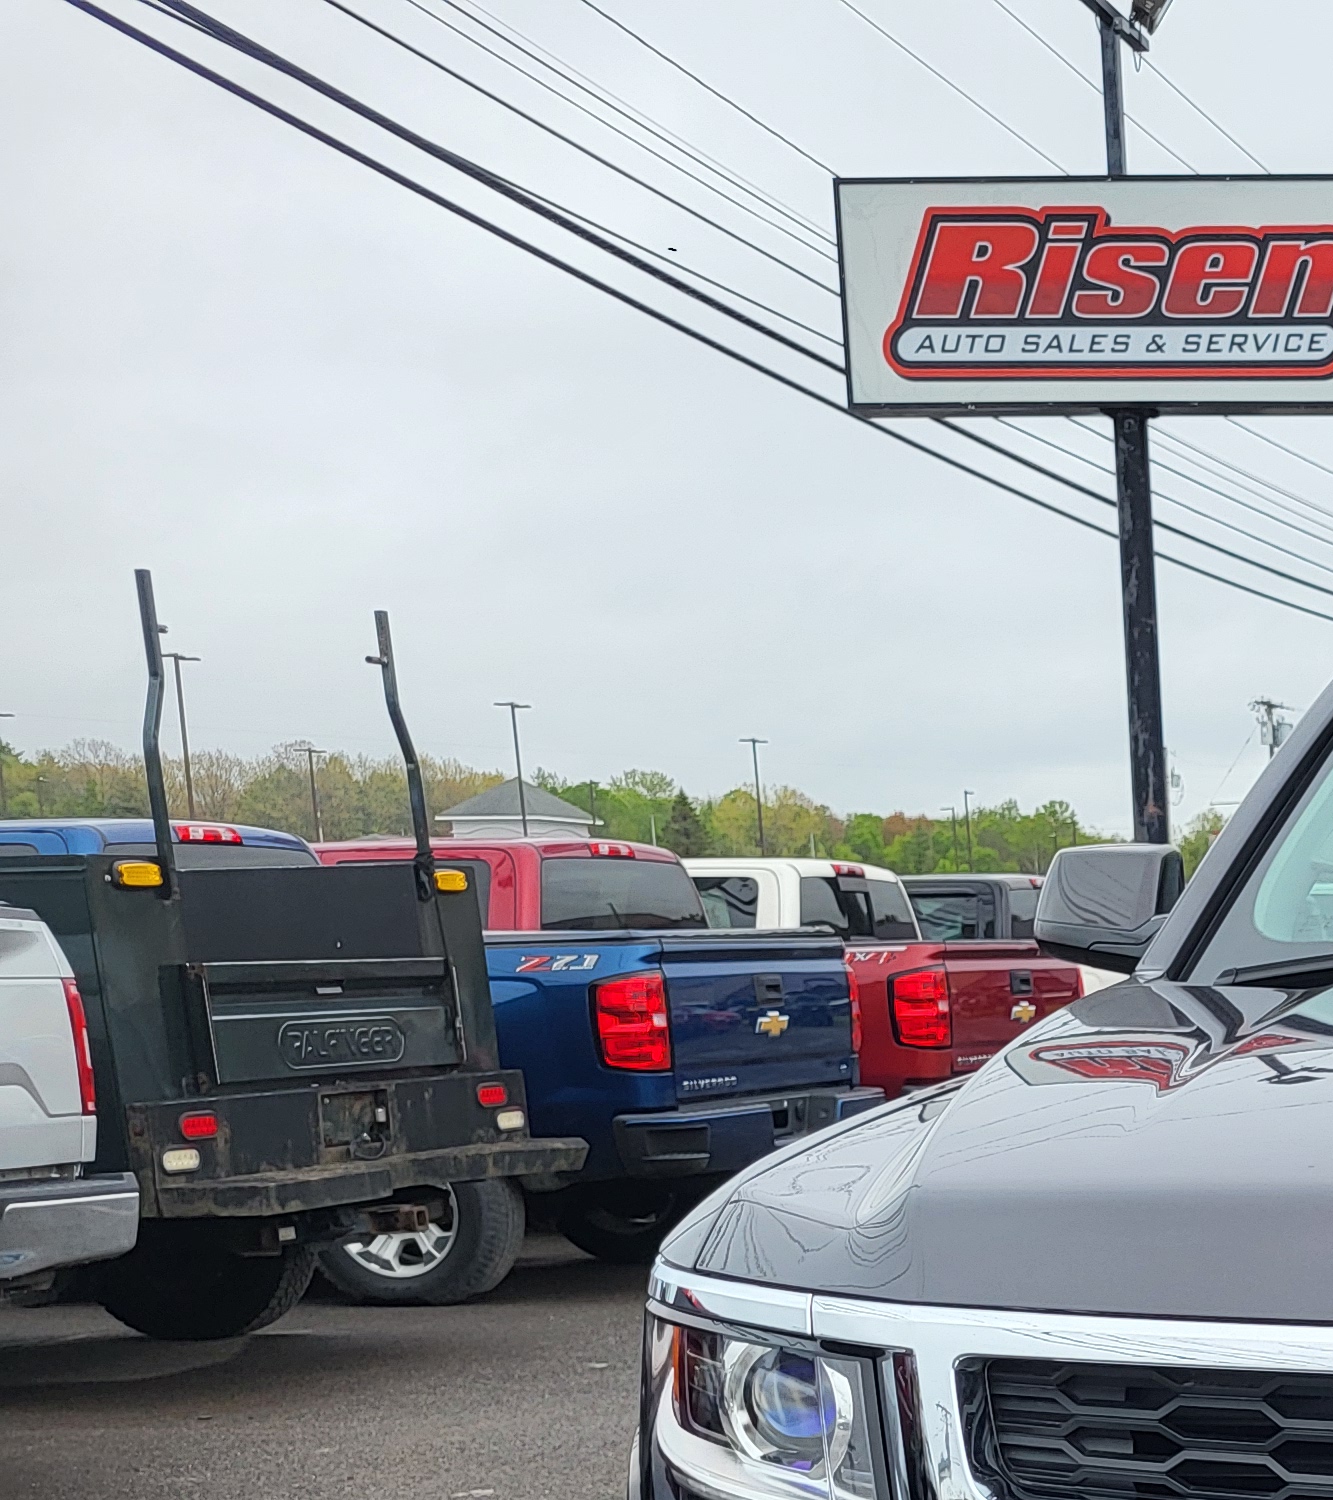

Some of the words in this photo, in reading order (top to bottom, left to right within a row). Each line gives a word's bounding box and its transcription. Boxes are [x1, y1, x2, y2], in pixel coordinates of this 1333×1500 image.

[914, 333, 1005, 355] AUTO
[1021, 333, 1132, 354] SALES
[1145, 333, 1167, 354] &
[1181, 332, 1329, 354] SERVICE
[515, 954, 600, 973] Z71
